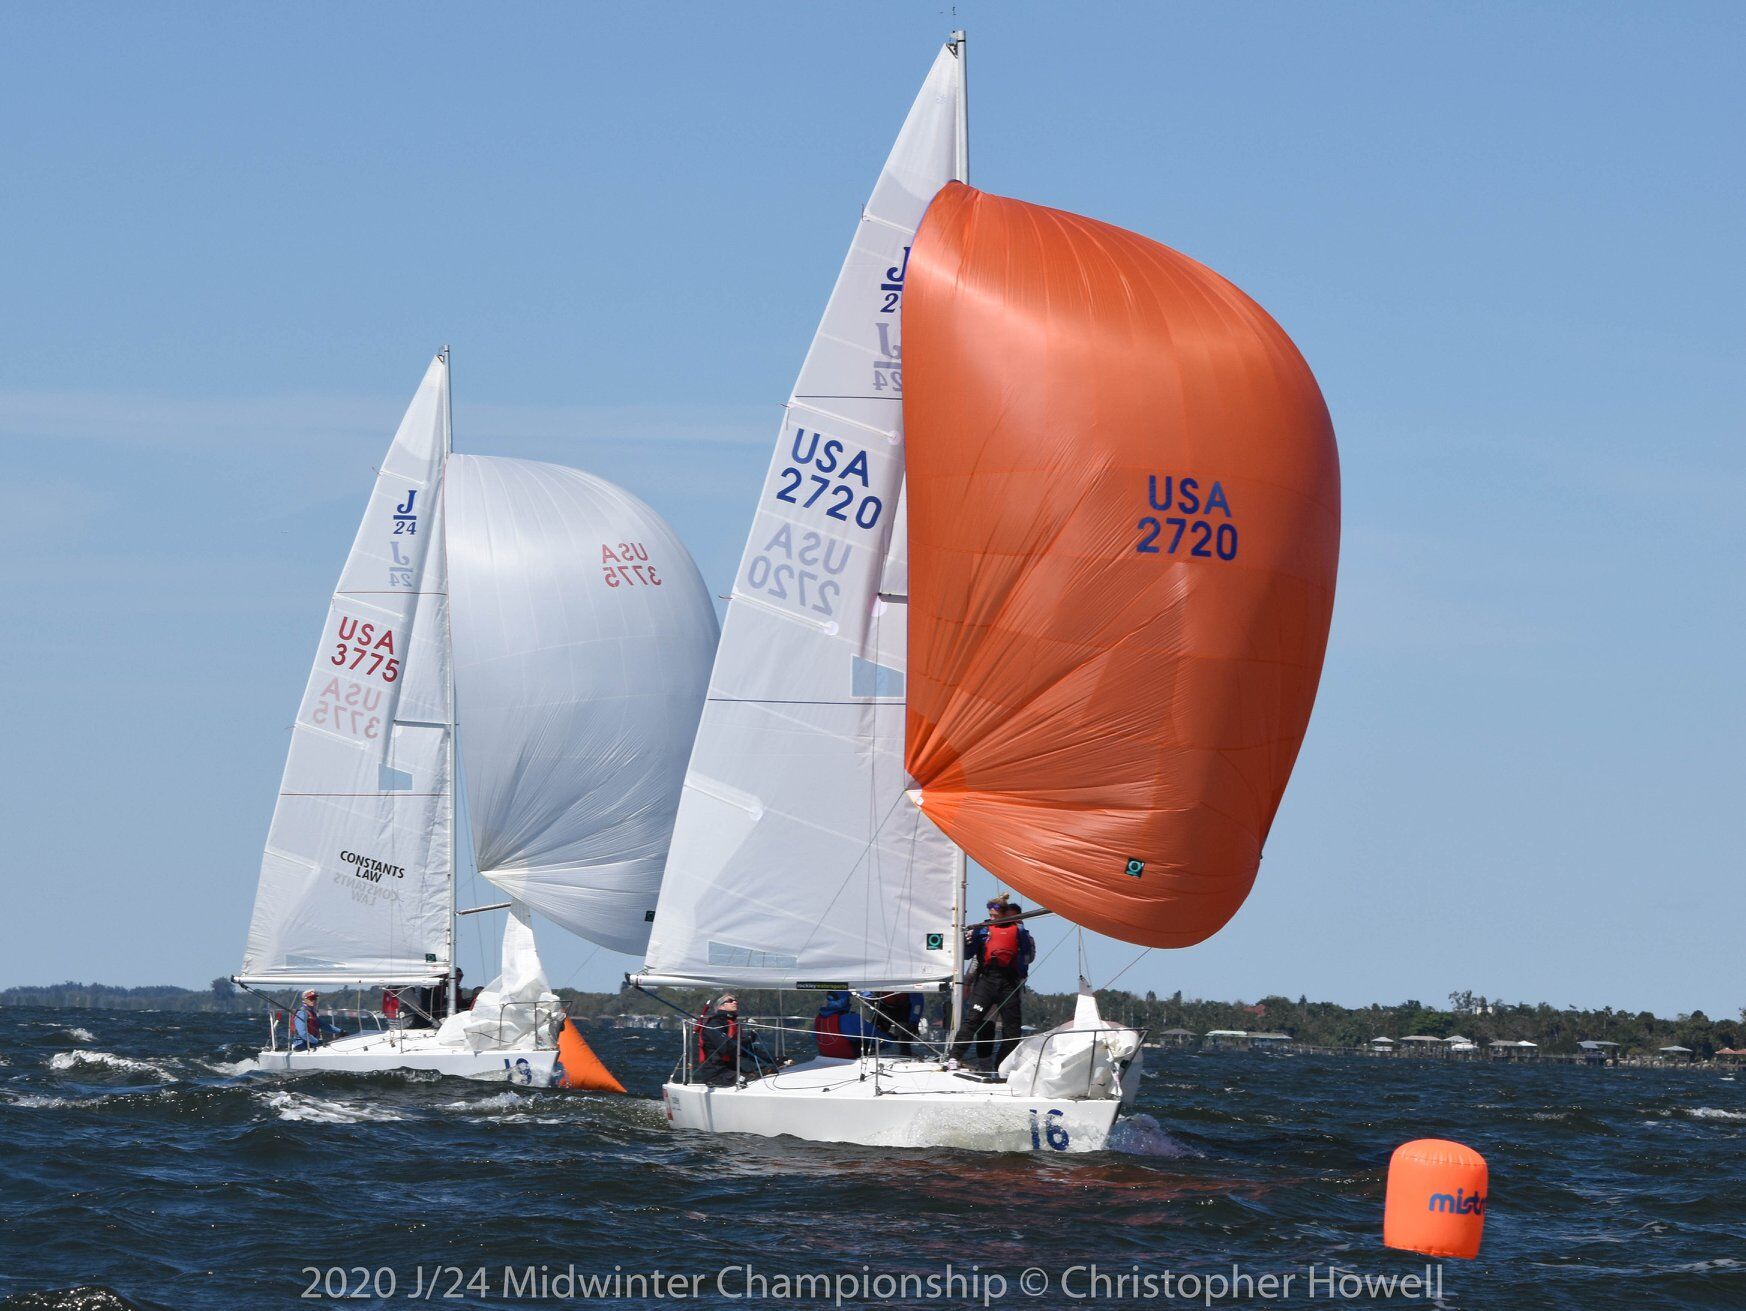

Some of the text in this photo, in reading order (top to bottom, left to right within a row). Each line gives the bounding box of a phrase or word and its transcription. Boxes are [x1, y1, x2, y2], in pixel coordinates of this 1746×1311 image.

[886, 246, 911, 282] J
[880, 292, 902, 313] 2
[791, 428, 869, 488] USA
[396, 489, 418, 514] J
[776, 467, 882, 529] 2720
[1148, 474, 1232, 518] USA
[393, 520, 417, 535] 24
[1136, 516, 1238, 560] 2720
[339, 616, 394, 655] USA
[331, 643, 399, 682] 3775
[340, 850, 405, 879] CONSTANTS
[355, 867, 382, 883] LAW
[1029, 1108, 1070, 1152] 16
